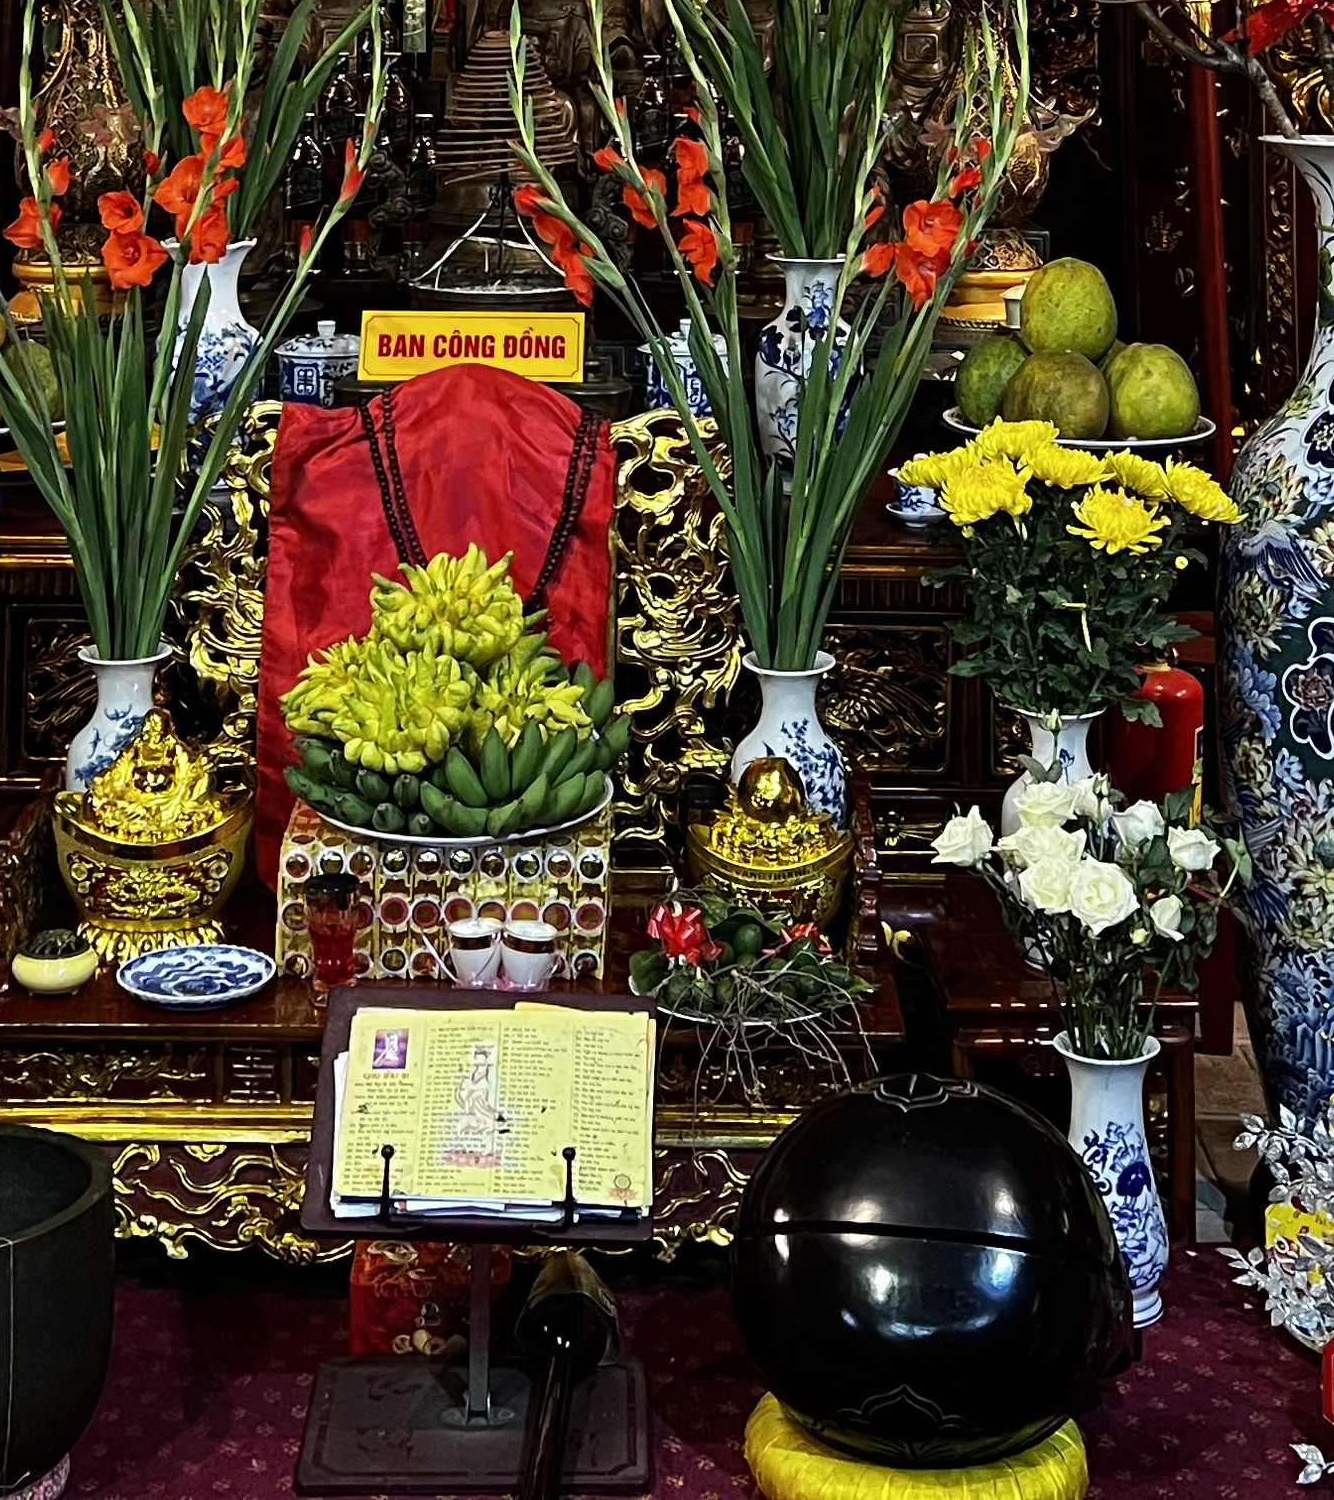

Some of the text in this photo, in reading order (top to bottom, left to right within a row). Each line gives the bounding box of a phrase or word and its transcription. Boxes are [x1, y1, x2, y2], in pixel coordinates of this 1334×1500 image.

[378, 326, 566, 360] BAN CÔNG ĐỒNG
